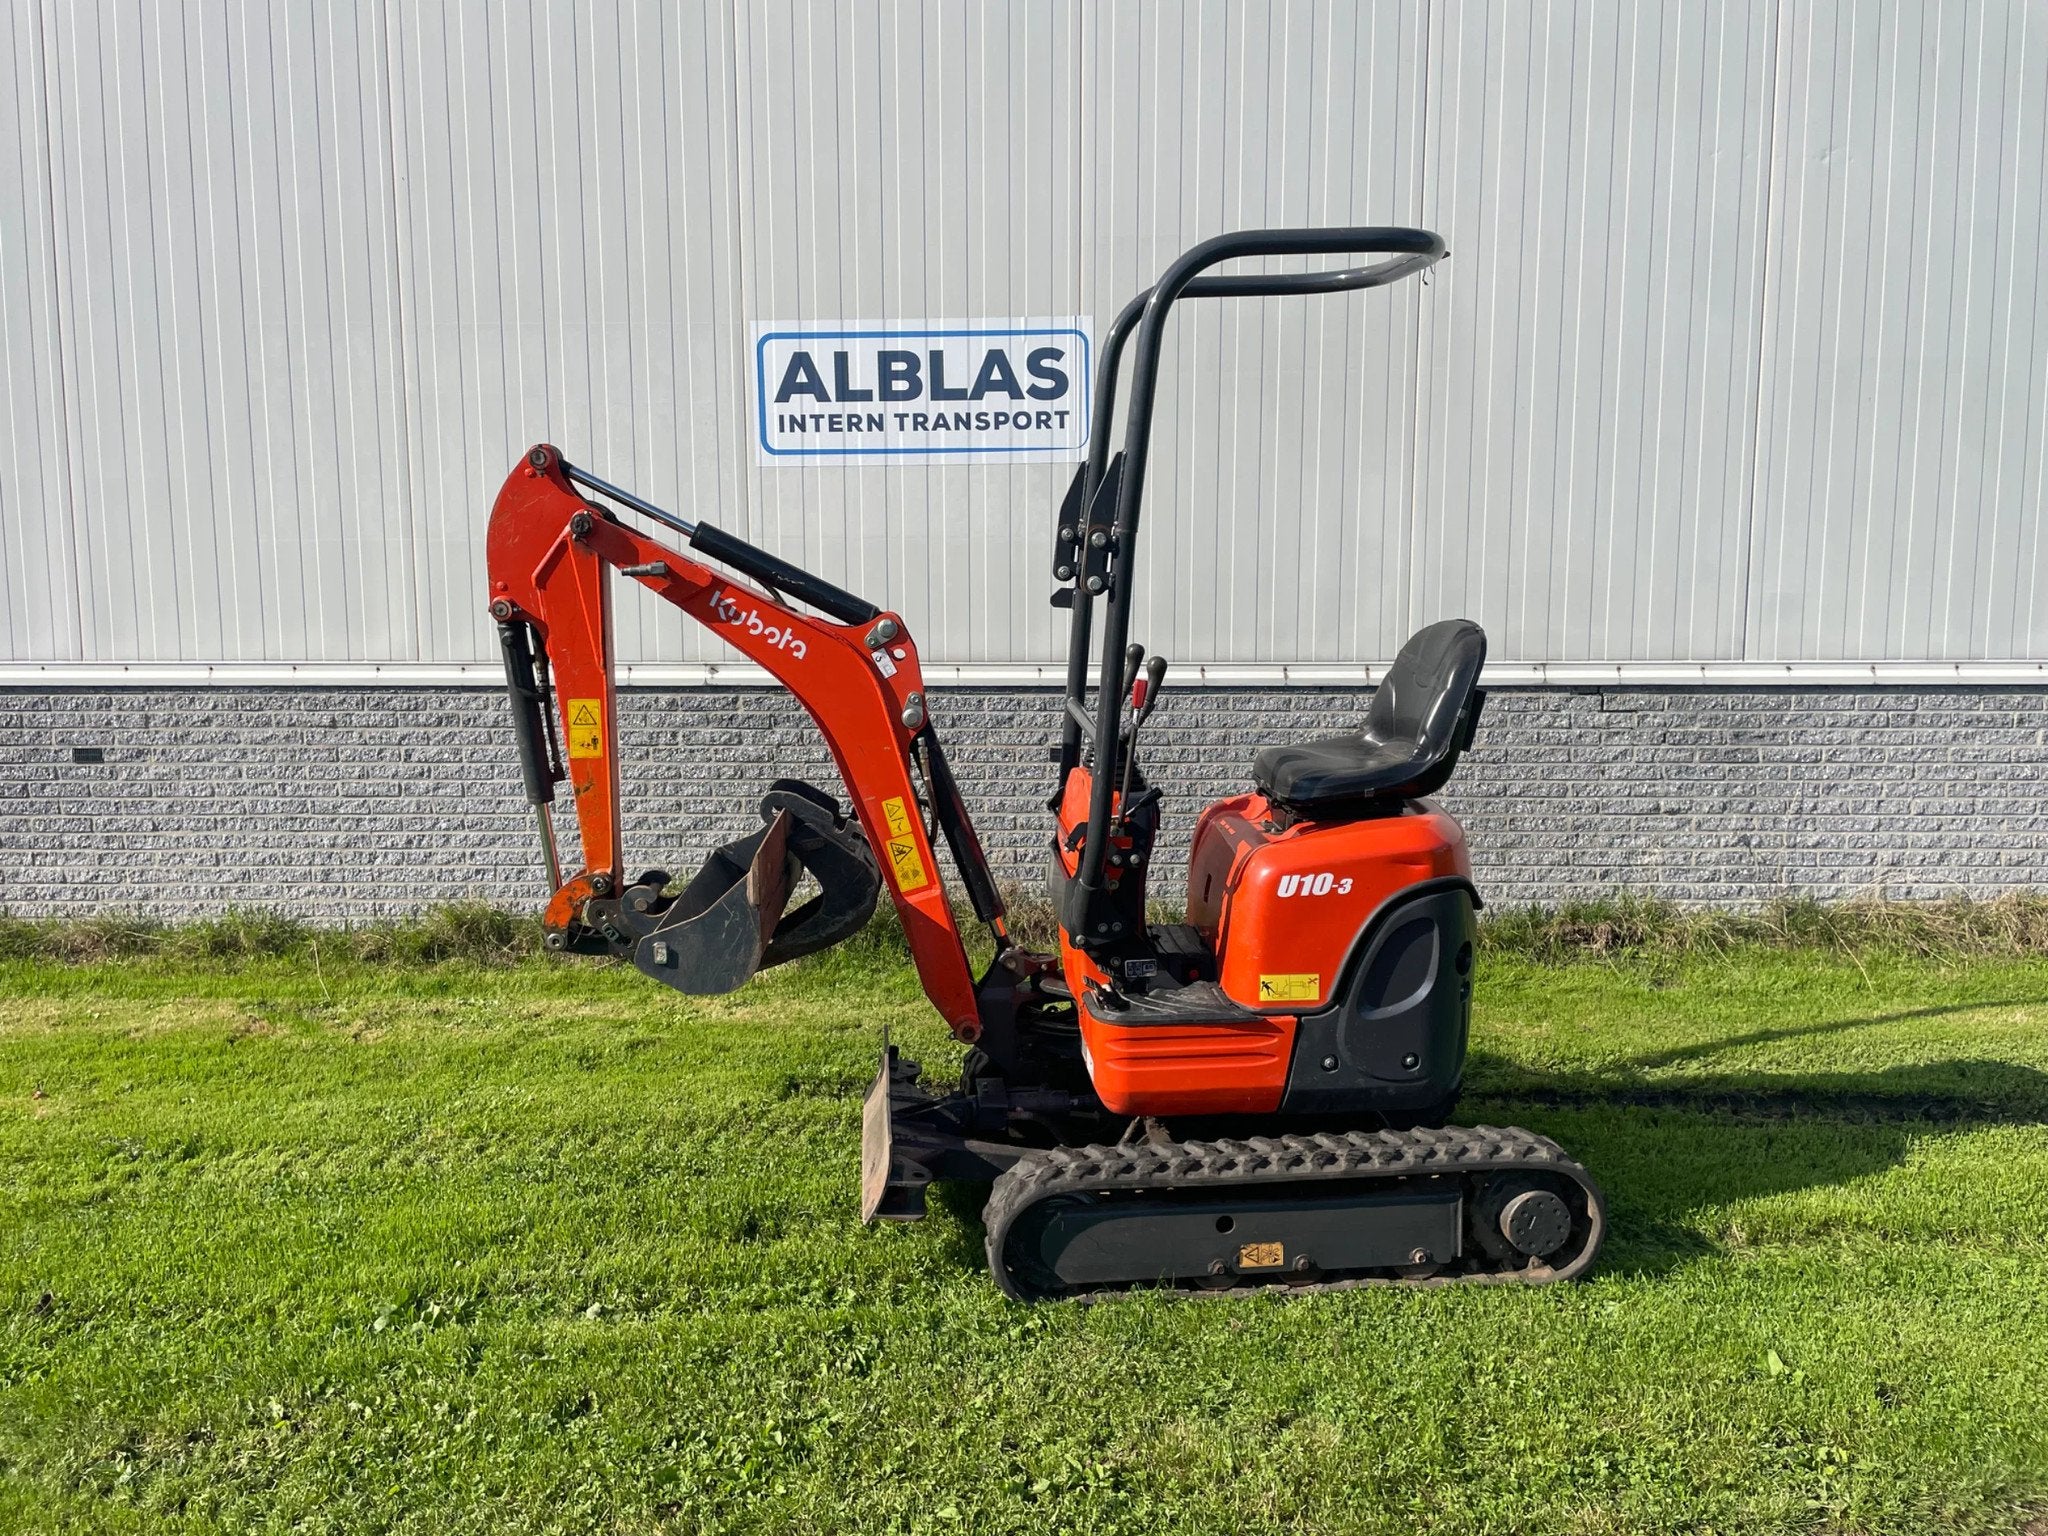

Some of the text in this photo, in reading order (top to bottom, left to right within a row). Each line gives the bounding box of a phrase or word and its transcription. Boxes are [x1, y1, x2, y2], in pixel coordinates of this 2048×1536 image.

[774, 347, 1070, 403] ALBLAS
[778, 410, 1070, 433] INTERN TRANSPORT
[709, 590, 808, 661] Kubota
[1277, 872, 1354, 898] U10-3
